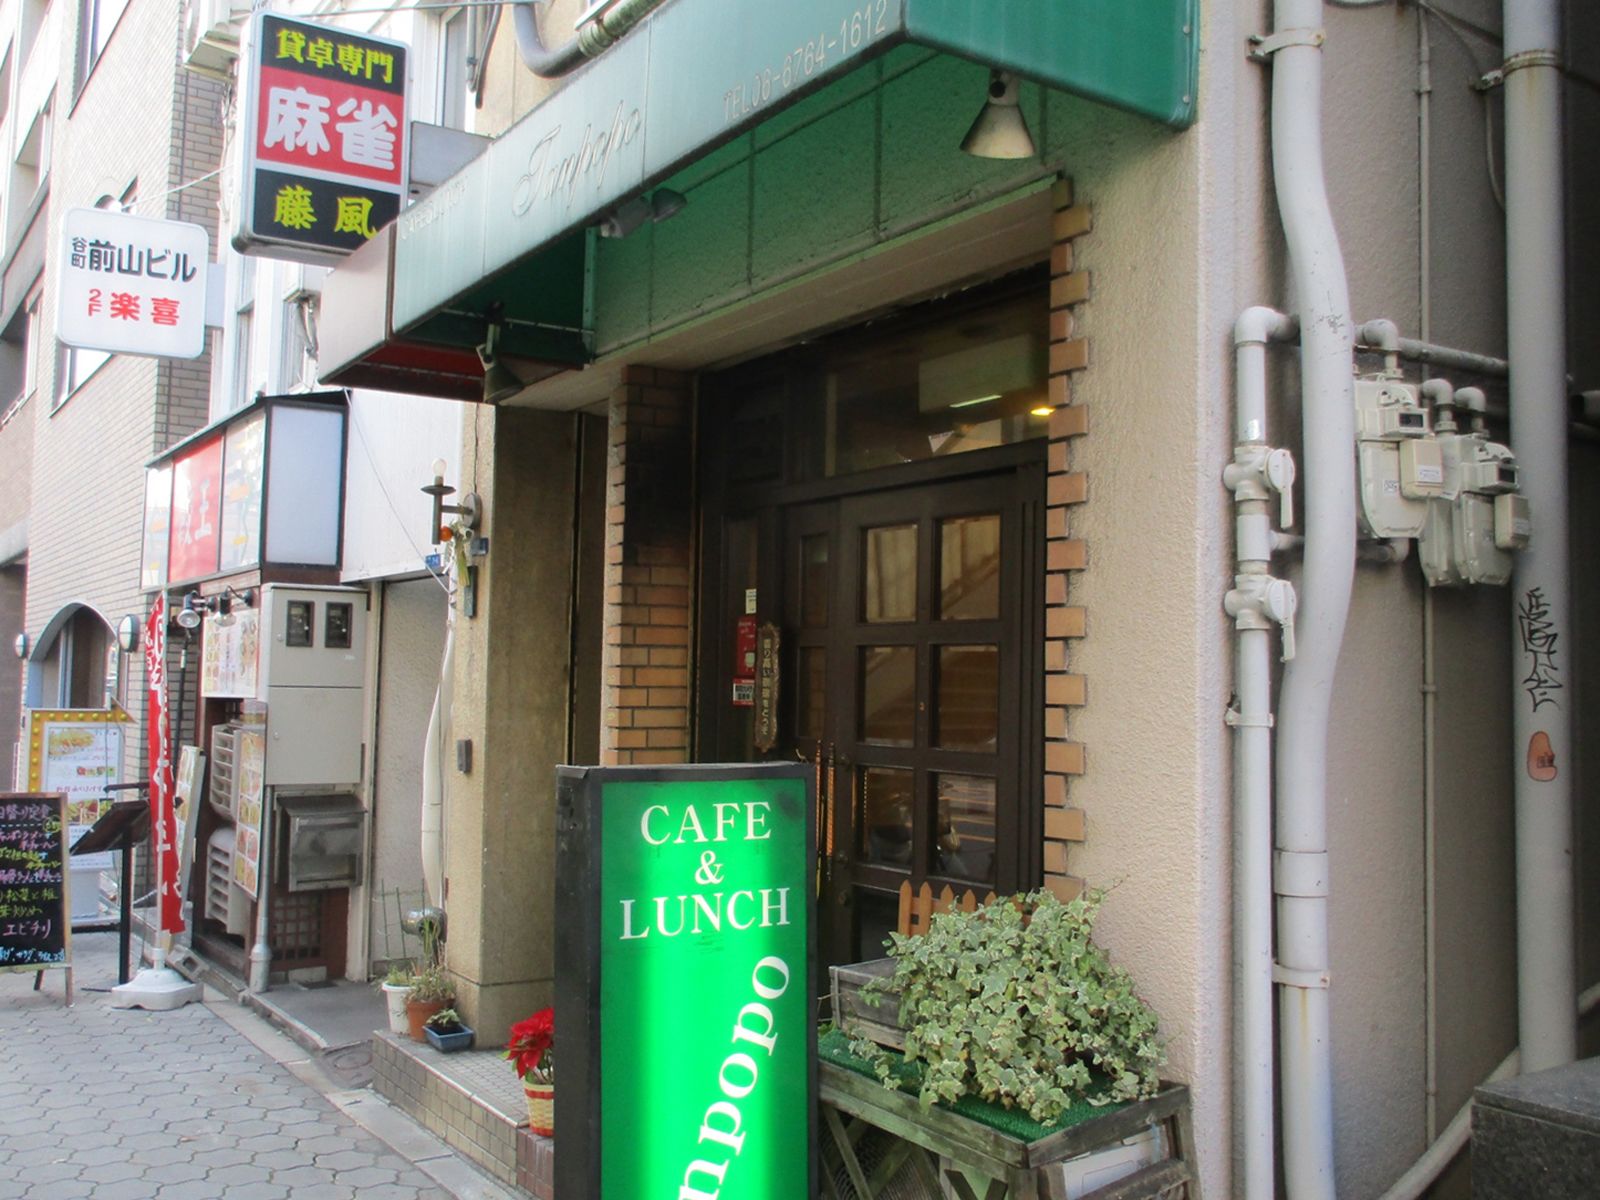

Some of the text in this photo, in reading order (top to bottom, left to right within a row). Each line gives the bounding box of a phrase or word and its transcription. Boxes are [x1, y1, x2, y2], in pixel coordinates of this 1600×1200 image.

[276, 28, 394, 84] 貸卓専門
[264, 87, 398, 171] 麻雀
[273, 184, 378, 240] 藤風
[88, 239, 198, 283] 前山ビル
[640, 801, 772, 845] CAFE
[694, 850, 725, 885] &
[2, 918, 52, 940] エビチリ
[619, 888, 791, 940] LUNCH
